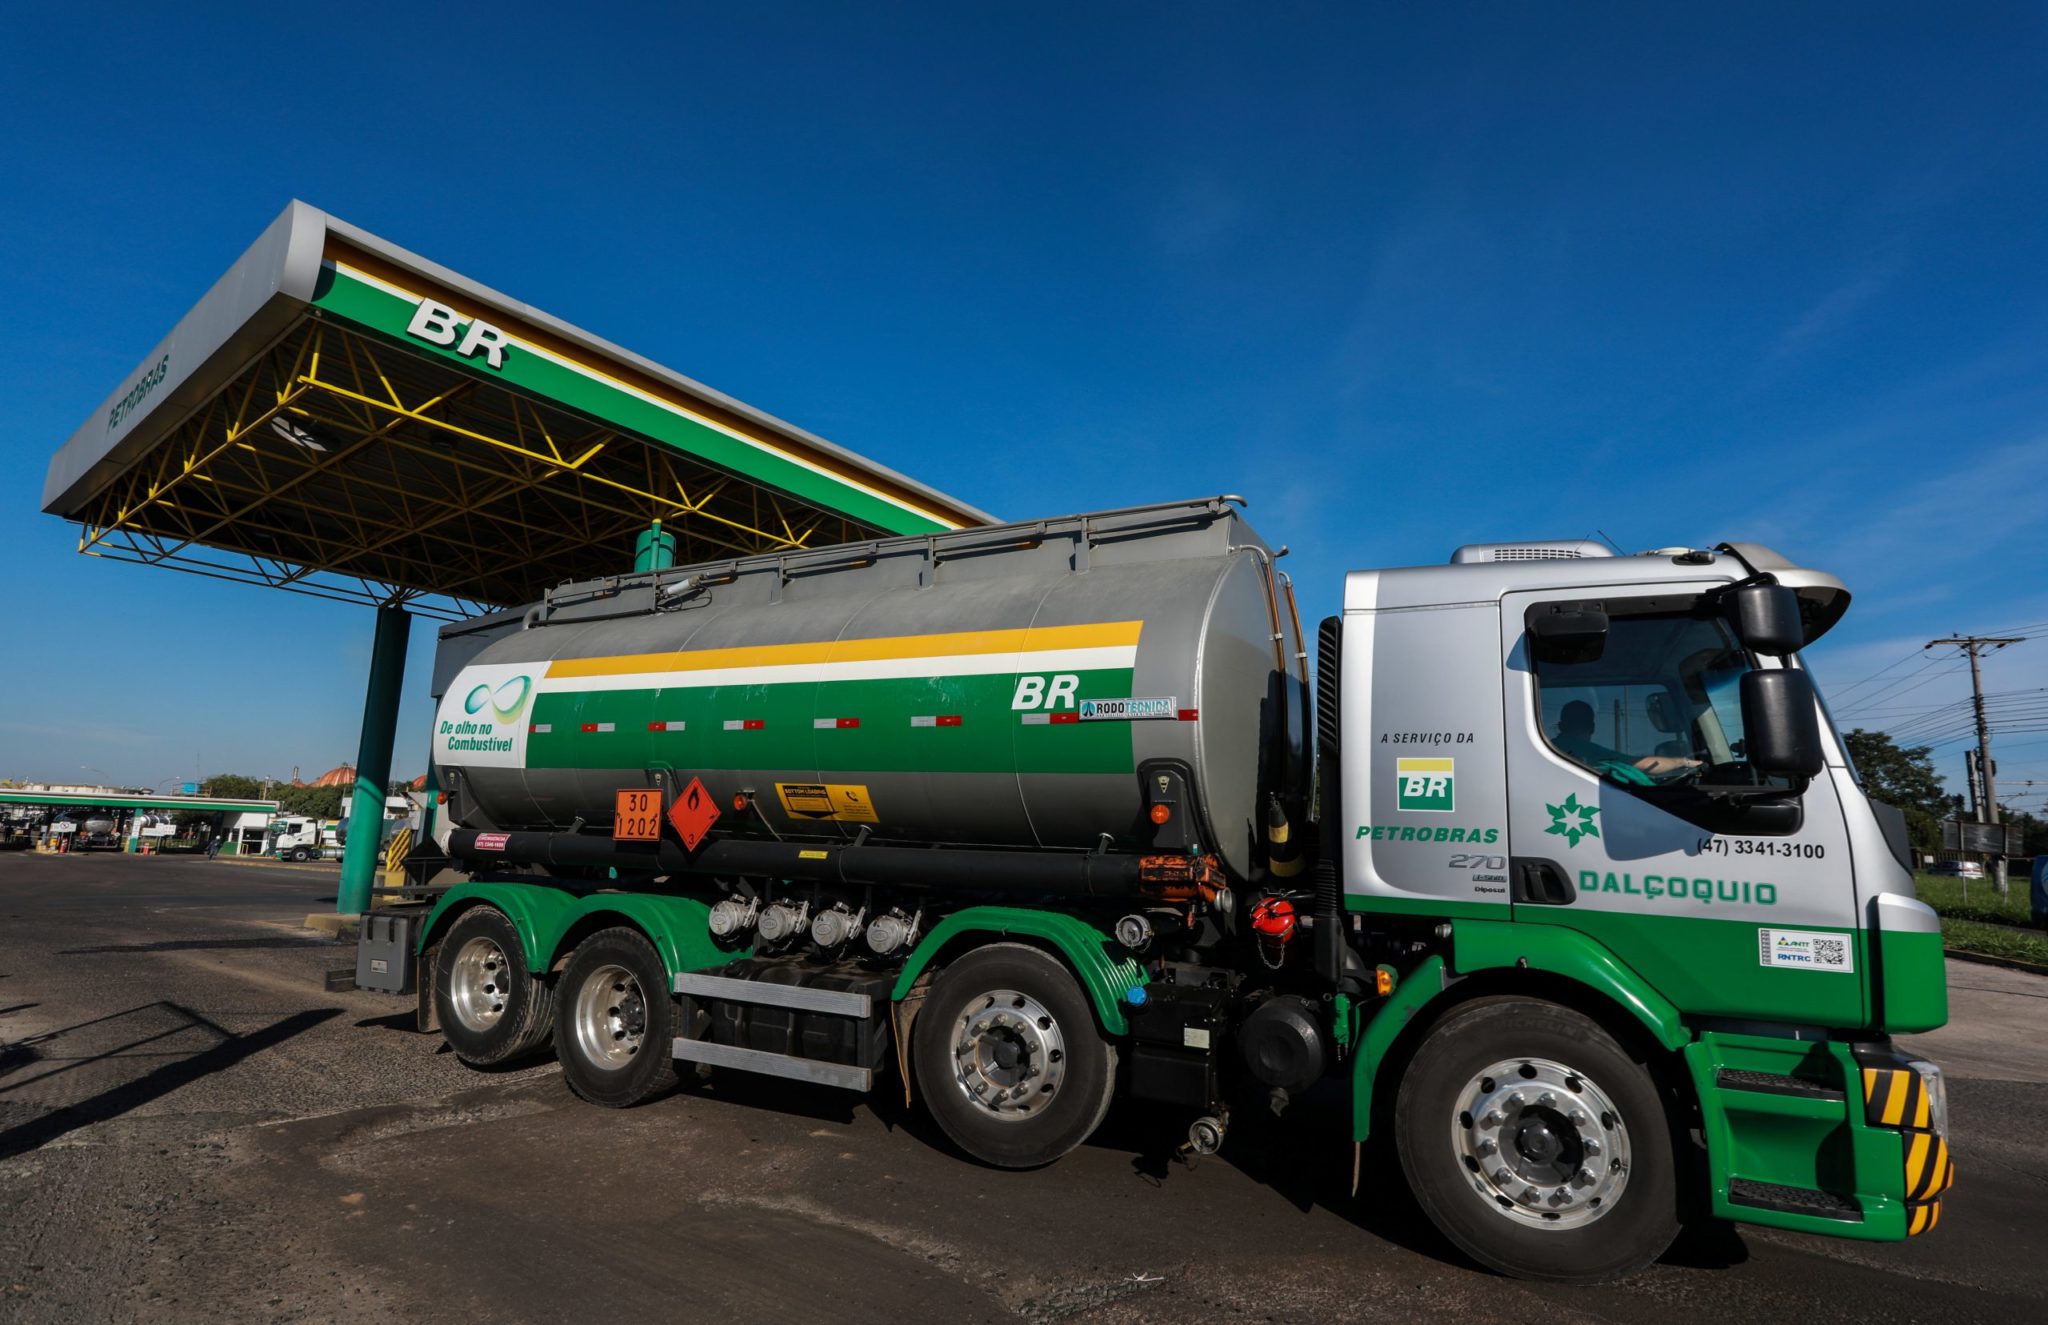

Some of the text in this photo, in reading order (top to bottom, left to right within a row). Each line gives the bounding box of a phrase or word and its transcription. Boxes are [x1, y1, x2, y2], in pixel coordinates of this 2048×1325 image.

[406, 297, 508, 369] BR
[106, 353, 169, 435] PETROBRAS
[1011, 674, 1080, 710] BR
[440, 720, 493, 735] De olho no
[447, 737, 513, 752] Combustível
[1381, 732, 1475, 746] A SERVIÇO DA
[1403, 777, 1448, 798] BR
[629, 794, 648, 812] 30
[617, 817, 657, 837] 1202
[1355, 826, 1499, 844] PETROBRAS
[688, 833, 695, 845] 3
[1697, 839, 1826, 859] (47) 3341-3100
[1449, 853, 1507, 870] 270
[1579, 870, 1777, 905] DALÇOQUIO
[1777, 953, 1811, 962] RNTRC
